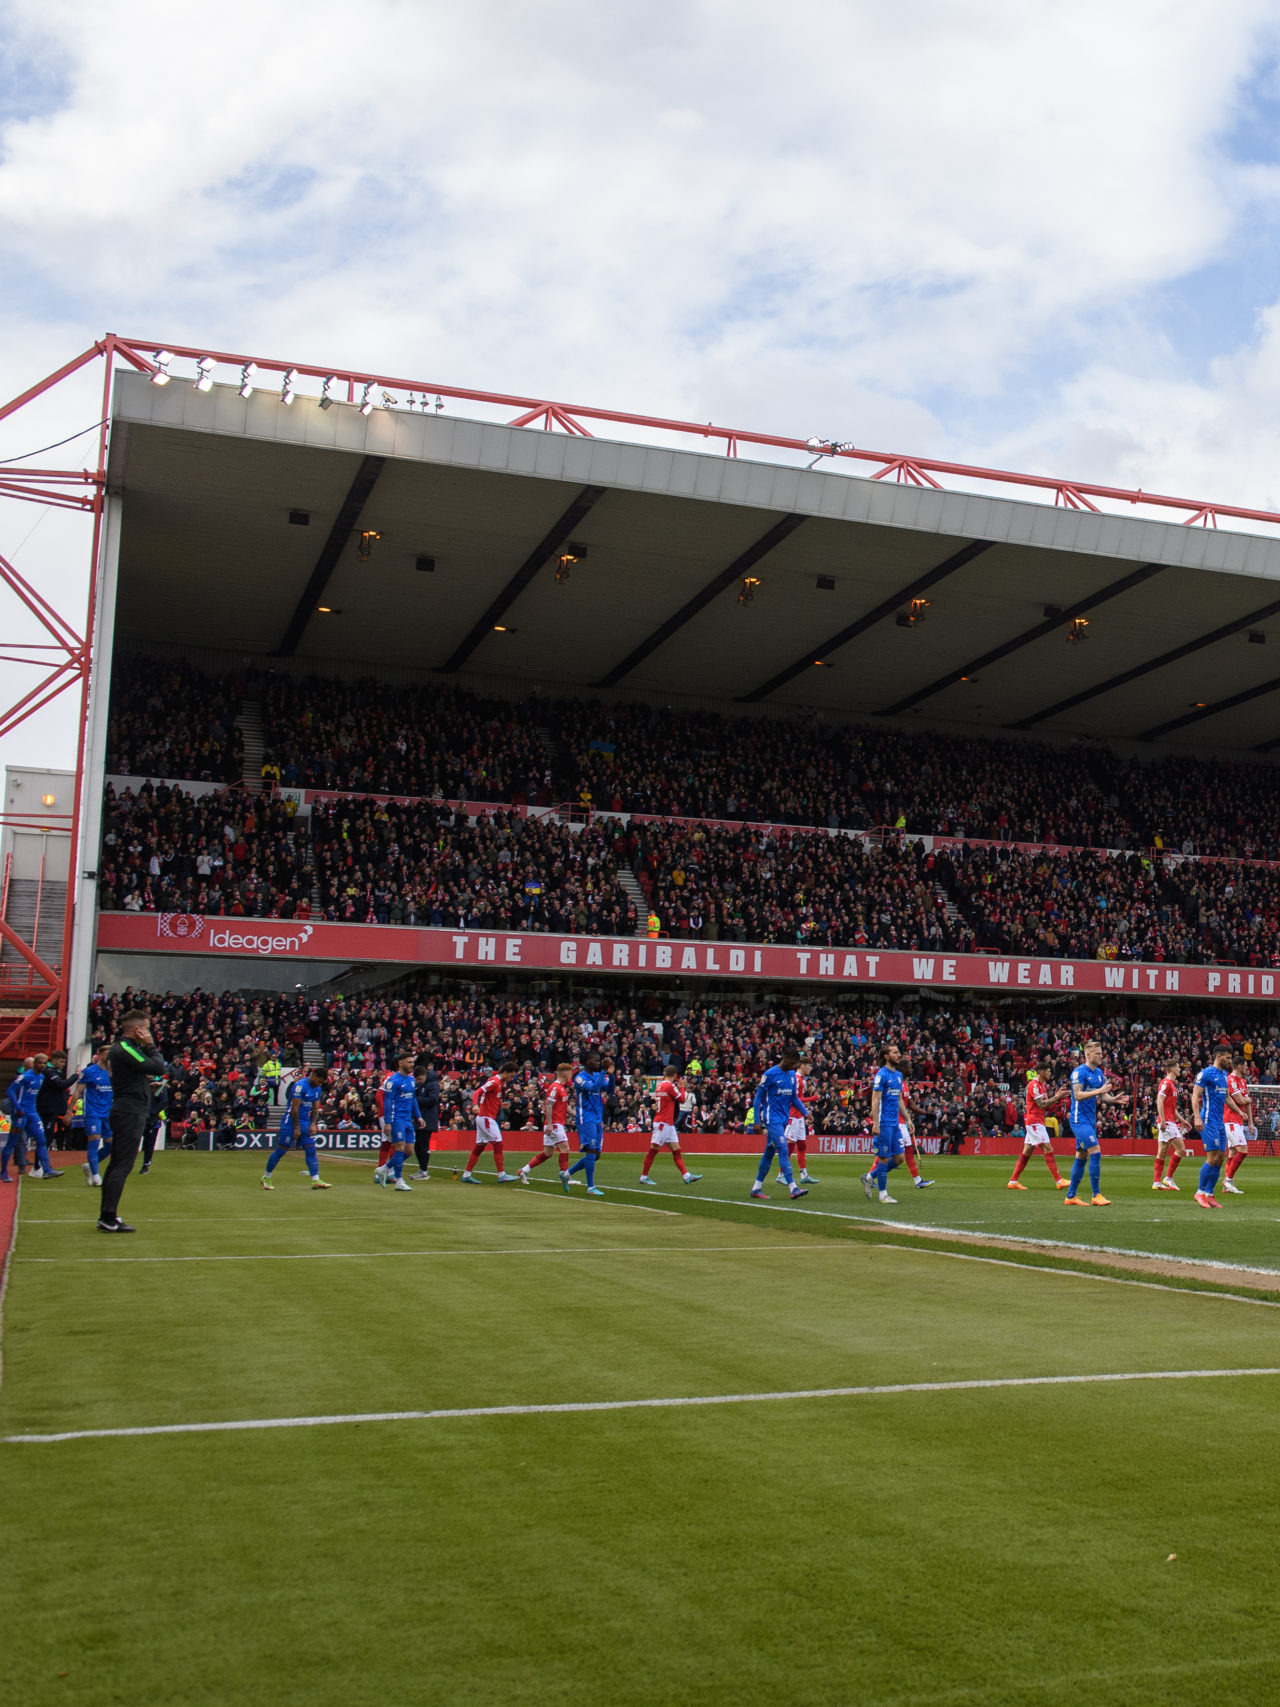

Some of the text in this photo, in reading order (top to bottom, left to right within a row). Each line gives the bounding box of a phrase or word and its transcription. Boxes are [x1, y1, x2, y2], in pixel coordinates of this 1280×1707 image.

[209, 929, 299, 954] Ideagen
[452, 936, 522, 962] THE
[560, 941, 762, 973] GARIBALDI
[797, 952, 880, 978] THAT
[912, 958, 957, 981] WE
[988, 961, 1075, 986] WEAR
[1104, 967, 1180, 991] WITH
[233, 1133, 382, 1148] OXT OILERS
[818, 1137, 846, 1153] TEAM
